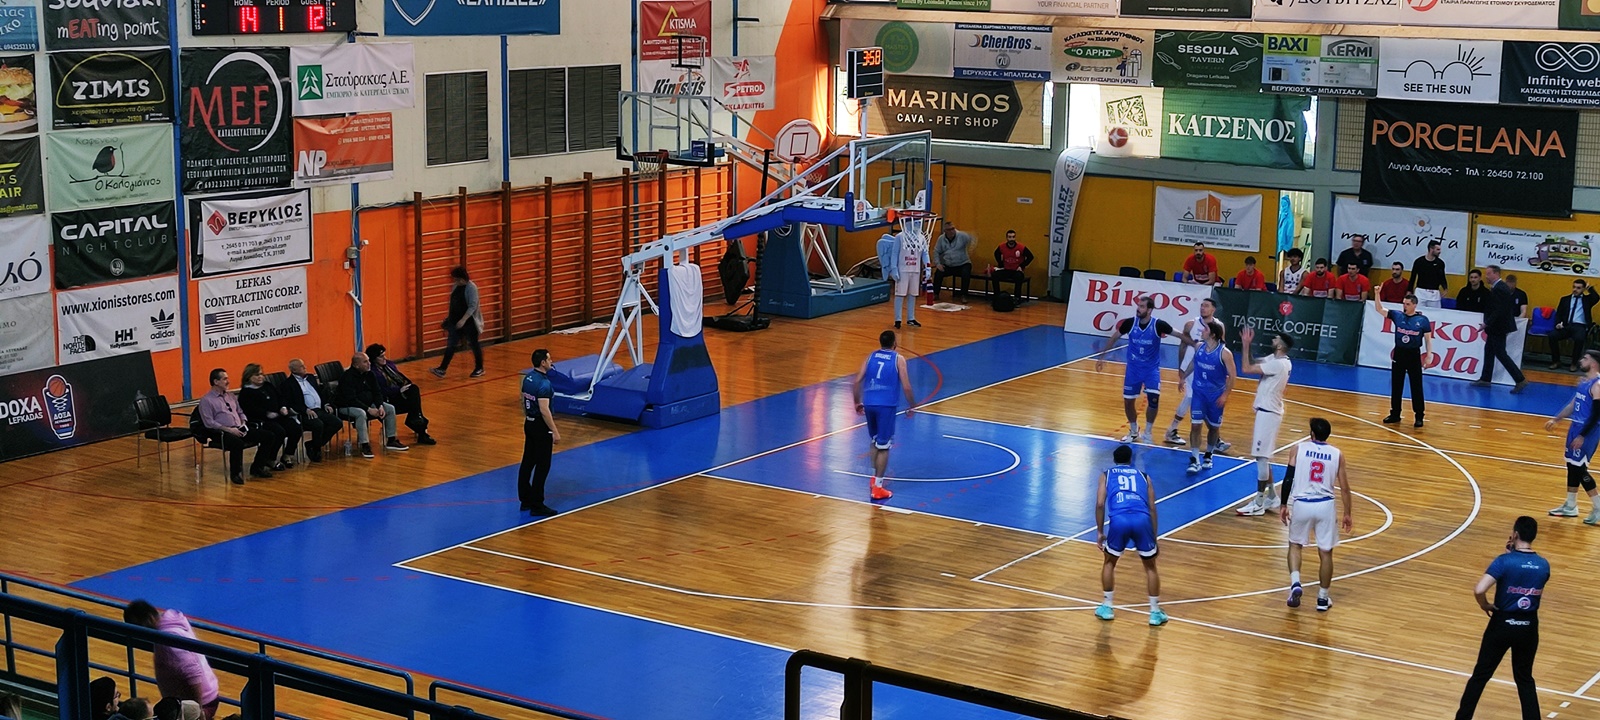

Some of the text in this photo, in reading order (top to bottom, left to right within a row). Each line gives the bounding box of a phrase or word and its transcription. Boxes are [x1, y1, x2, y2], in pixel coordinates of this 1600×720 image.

[240, 6, 259, 33] 14
[308, 5, 325, 31] 12
[669, 18, 697, 30] KTISMA
[57, 17, 160, 41] mEATing point
[981, 34, 1032, 49] CherBros
[1178, 44, 1239, 55] SESOULA
[1267, 36, 1308, 51] BAXI
[1327, 39, 1372, 57] KERMI
[326, 70, 410, 90] Σταύρακας Α.Ε.
[1403, 83, 1471, 95] SEE THE SUN
[1528, 75, 1573, 88] Infinity
[72, 79, 150, 100] ZIMIS
[187, 85, 270, 128] MEF
[888, 88, 1010, 113] MARINOS
[1557, 97, 1600, 105] MARKETING
[897, 113, 925, 124] CAVA
[936, 116, 959, 126] PET
[964, 117, 999, 128] SHOP
[1168, 112, 1296, 143] ΚΑΤΣΕΝΟΣ
[1371, 119, 1566, 158] PORCELANA
[298, 150, 327, 177] NP
[1487, 169, 1513, 179] 26450
[1516, 171, 1544, 180] 72.100
[227, 203, 303, 226] ΒΕΡΥΚΙΟΣ
[60, 215, 168, 240] CAPITAL
[62, 234, 168, 256] NIGHTCLUB
[236, 275, 272, 290] LEFKAS
[61, 288, 175, 316] www.xionisstores.com
[204, 285, 302, 308] CONTRACTING CORP.
[236, 301, 304, 318] General Contractor
[236, 318, 261, 330] in NYC
[114, 328, 134, 343] HH
[150, 329, 175, 340] adidas
[209, 323, 301, 349] by Dimitrios S. Karydis
[63, 339, 85, 350] NORTH
[876, 361, 885, 379] 7
[8, 412, 44, 425] LEFKADAS
[1309, 461, 1325, 483] 2
[1118, 475, 1137, 492] 91
